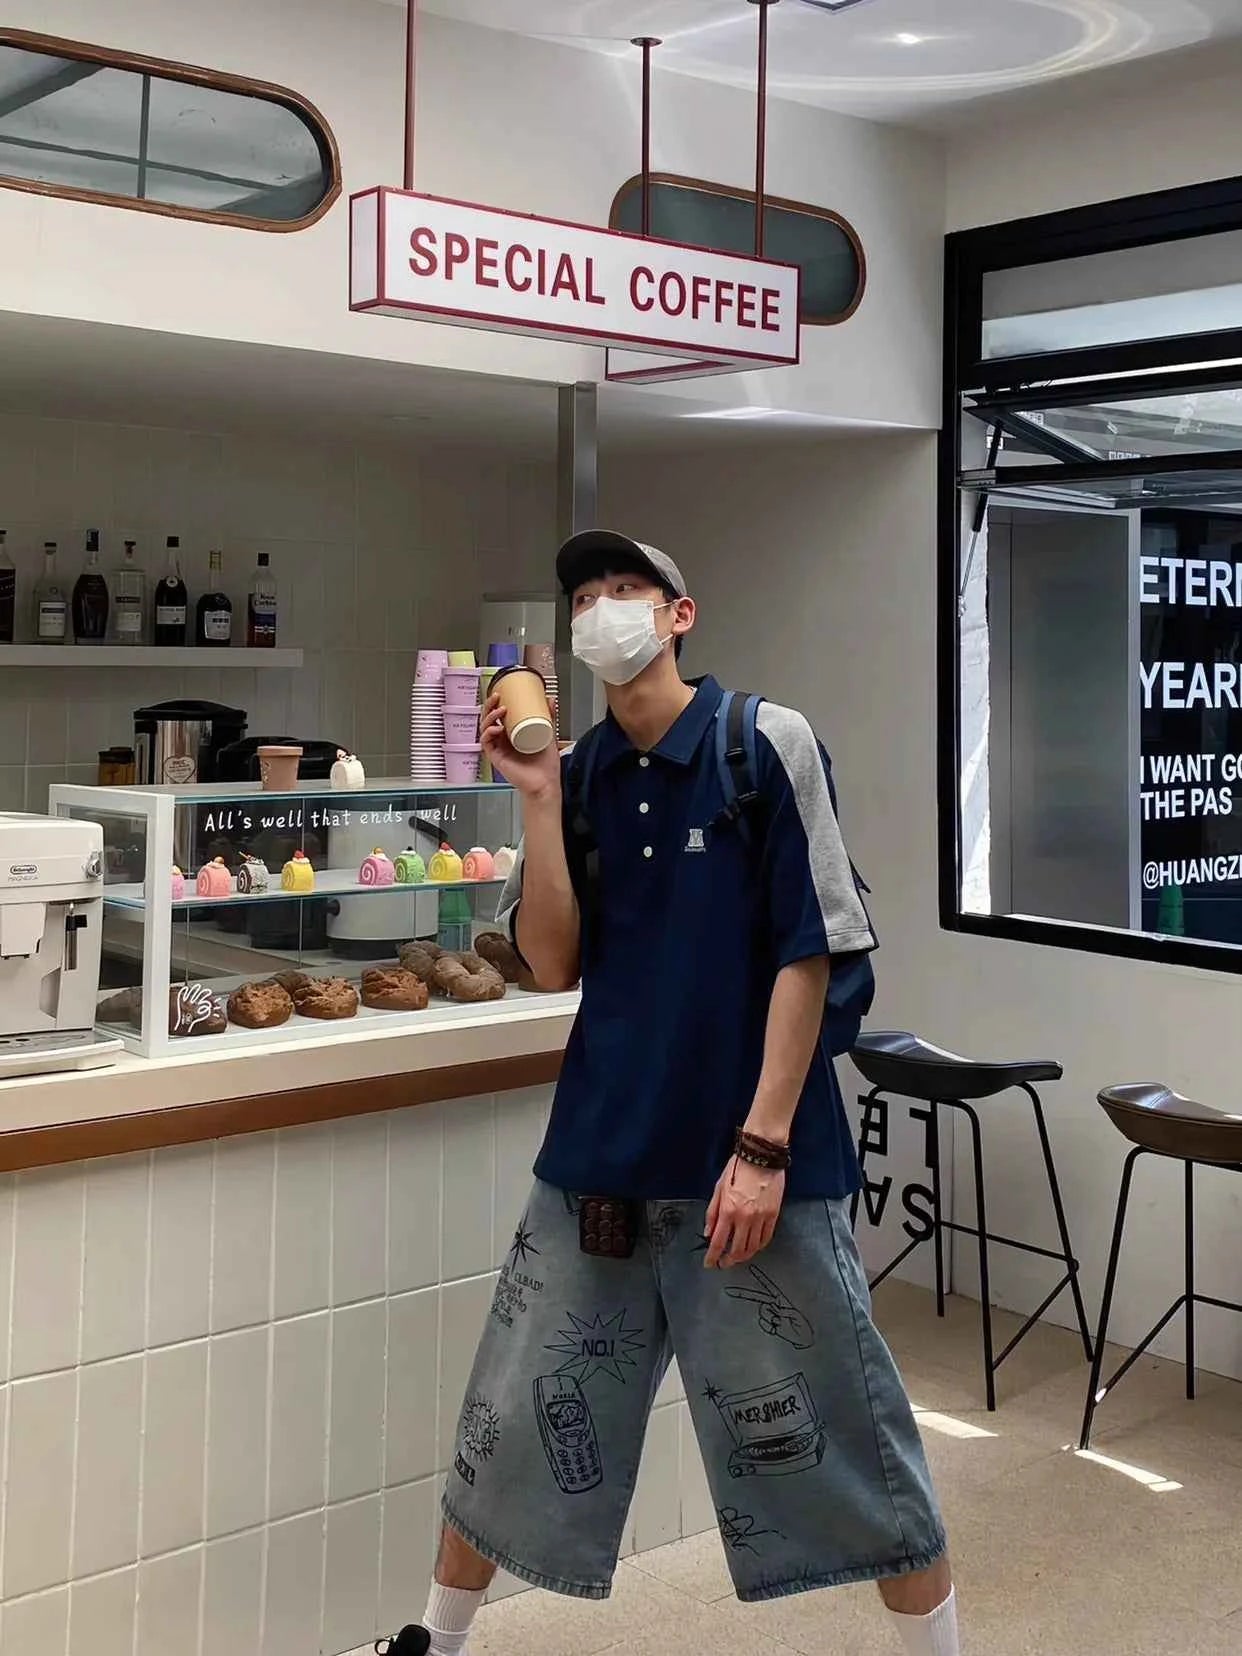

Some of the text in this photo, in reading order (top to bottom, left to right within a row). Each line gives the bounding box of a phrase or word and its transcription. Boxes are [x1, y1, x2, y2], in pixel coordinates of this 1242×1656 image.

[408, 226, 782, 332] SPECIAL COFFEE
[1139, 660, 1242, 709] YEAR
[1139, 755, 1145, 785] I
[1149, 754, 1216, 785] WANT
[204, 804, 458, 832] All's well that ends well
[1139, 786, 1233, 821] THE PAS
[1142, 854, 1242, 890] @HUANGZ
